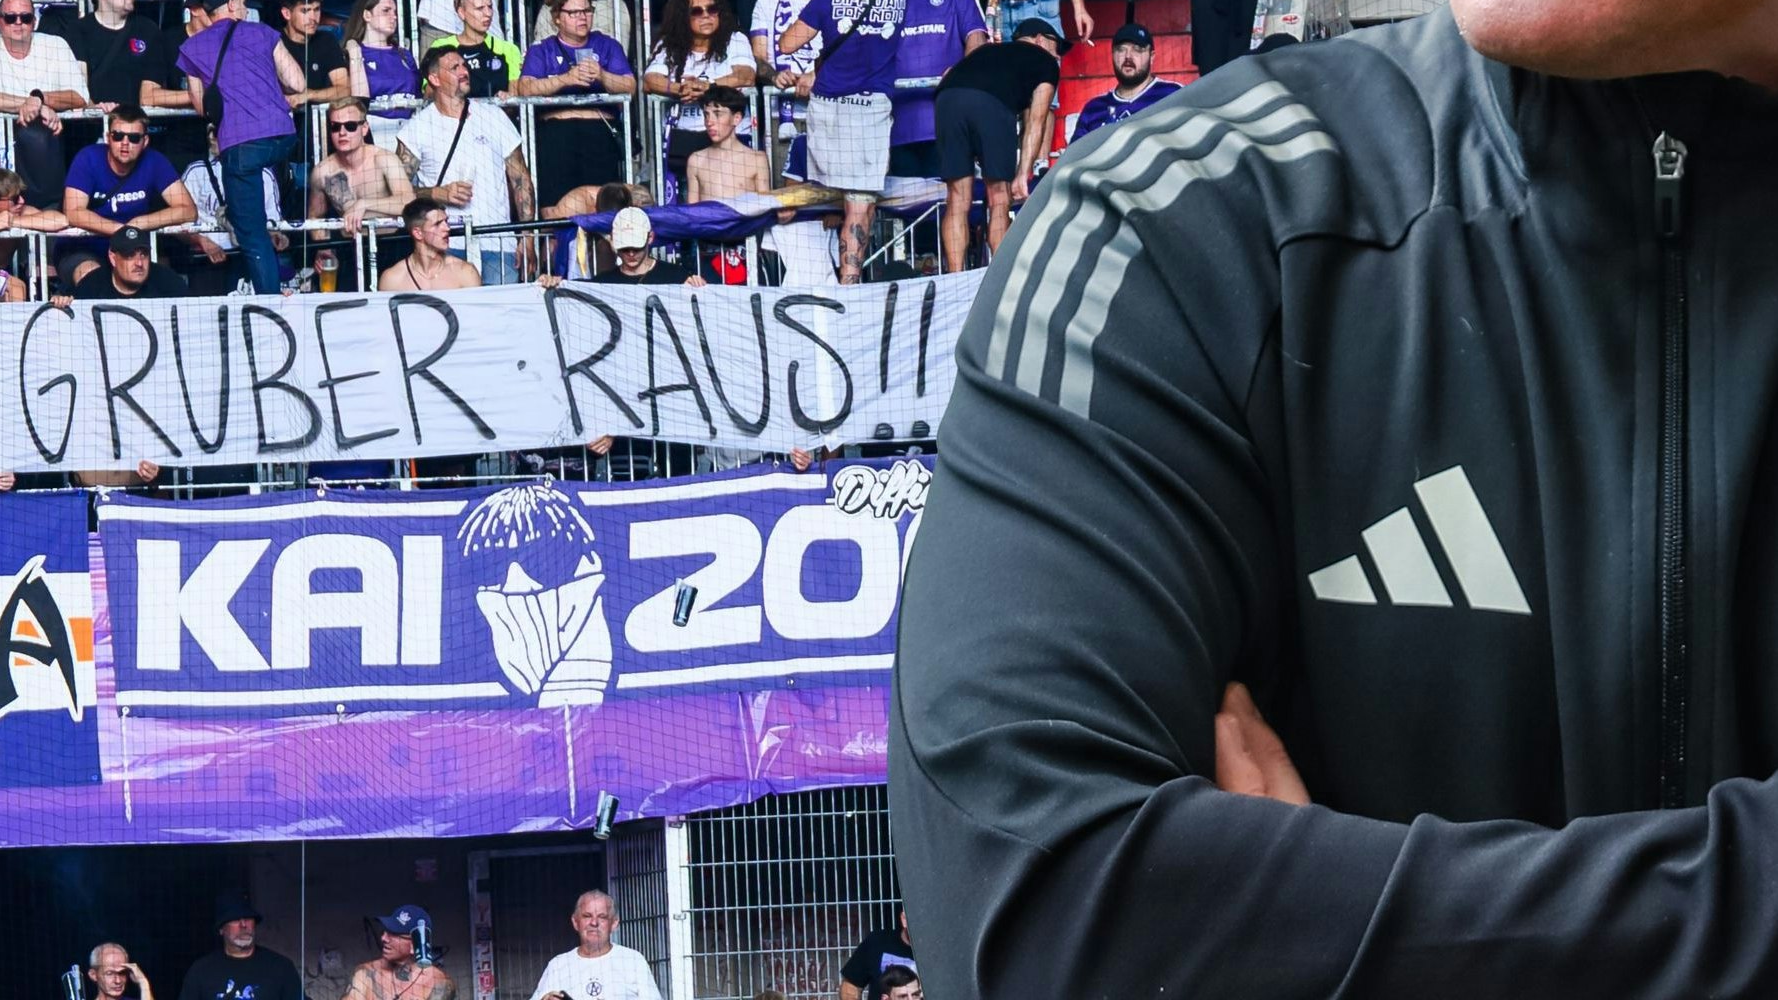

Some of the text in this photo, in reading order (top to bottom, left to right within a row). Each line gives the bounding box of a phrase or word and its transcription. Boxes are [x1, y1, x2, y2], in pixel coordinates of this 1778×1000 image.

[19, 294, 496, 464] GRUBER
[544, 280, 936, 440] RAUS!!
[136, 504, 920, 672] KAI 20
